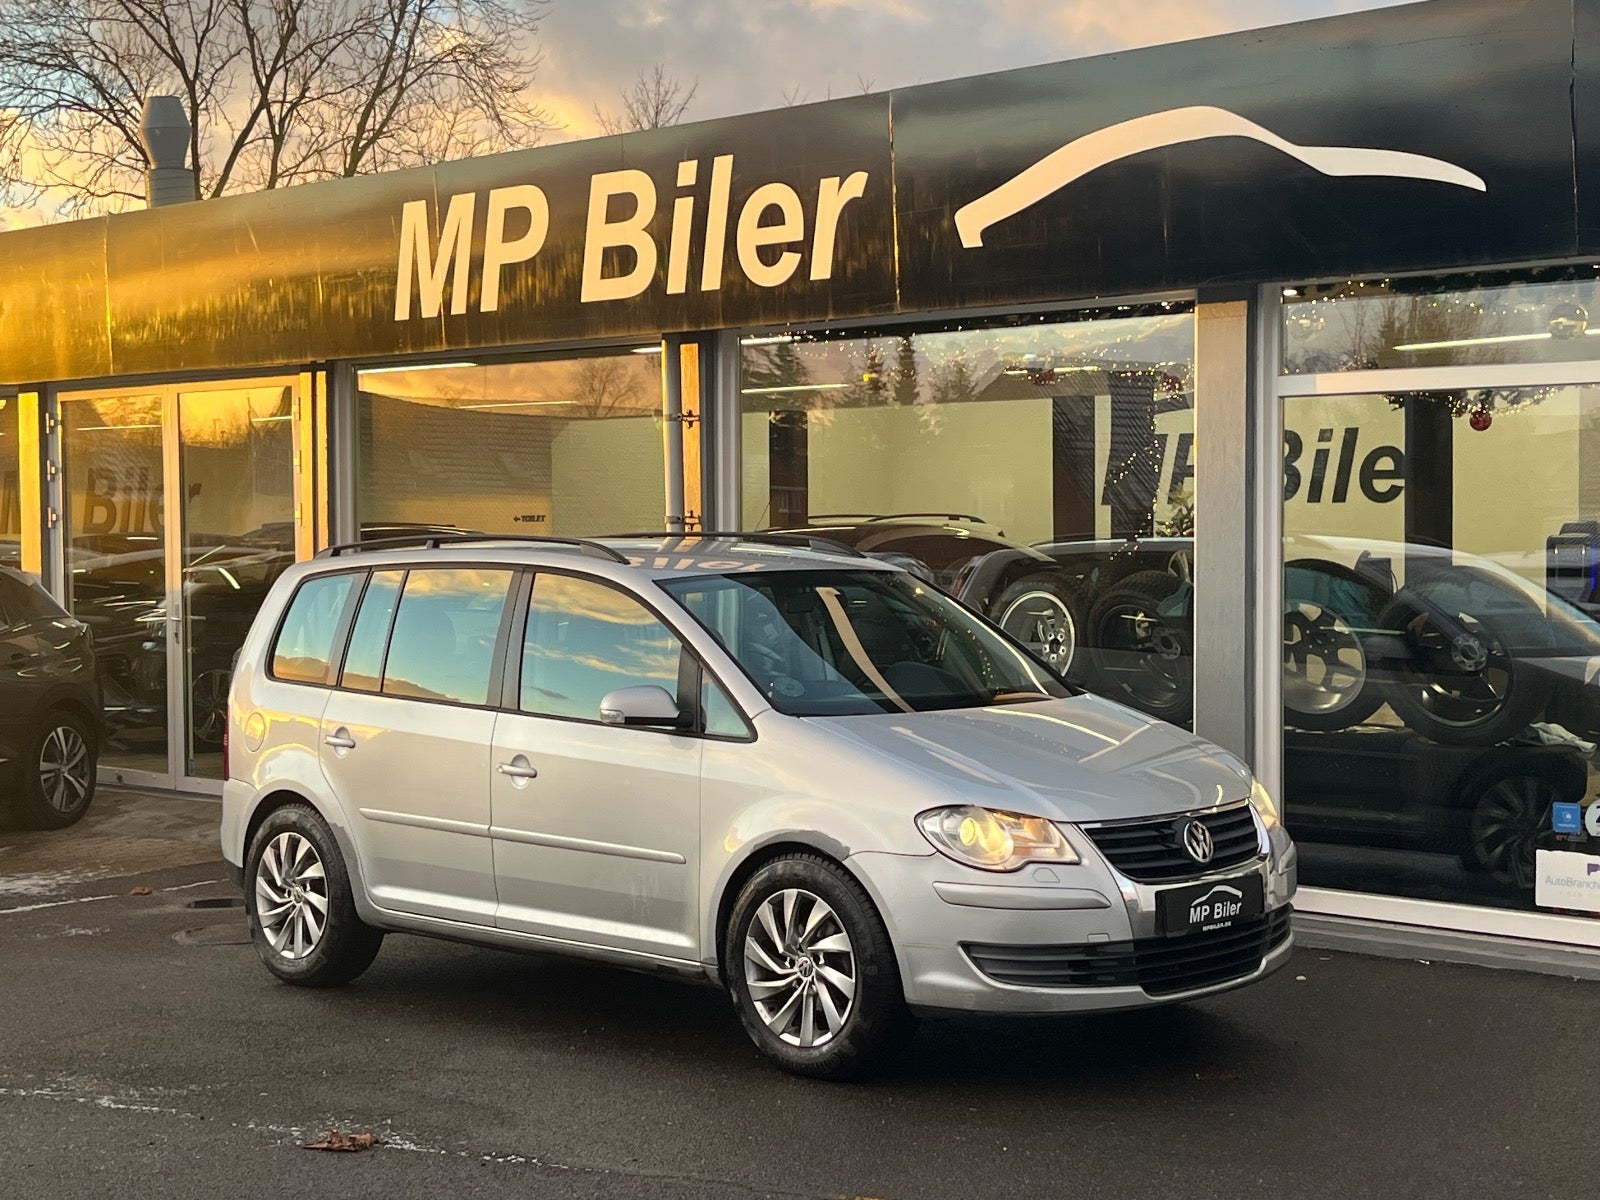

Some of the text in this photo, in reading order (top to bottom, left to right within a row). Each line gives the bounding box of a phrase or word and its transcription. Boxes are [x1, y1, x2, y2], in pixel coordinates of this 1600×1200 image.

[394, 154, 868, 321] MP Biler
[1189, 902, 1242, 924] MP Biler
